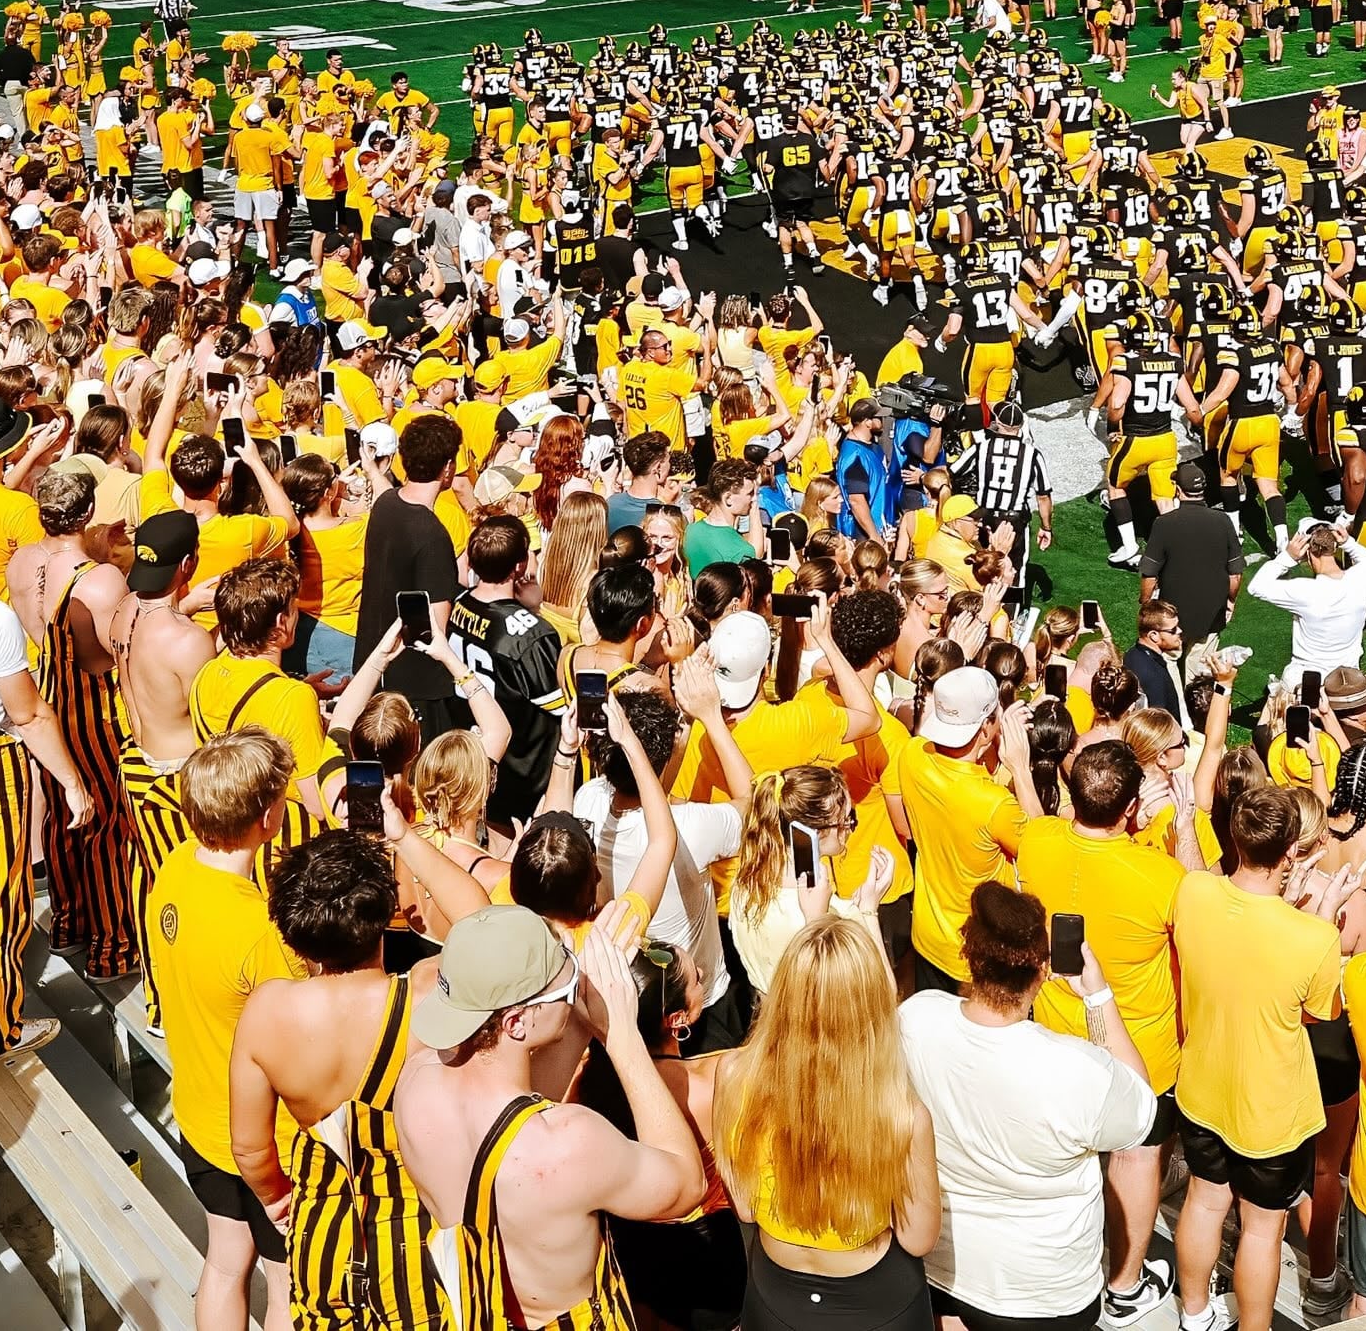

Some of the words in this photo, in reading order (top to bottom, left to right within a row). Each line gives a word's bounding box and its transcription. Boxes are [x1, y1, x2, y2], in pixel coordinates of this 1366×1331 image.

[485, 73, 511, 96] 33
[1060, 96, 1093, 123] 72
[667, 121, 698, 150] 74
[782, 145, 811, 167] 65
[886, 171, 911, 201] 14
[1329, 180, 1341, 210] 1
[972, 289, 1008, 329] 13
[1336, 356, 1354, 398] 1
[624, 385, 648, 412] 26
[1134, 372, 1179, 414] 50
[989, 458, 1017, 491] H
[450, 601, 491, 641] KITTLE
[505, 609, 539, 636] 46
